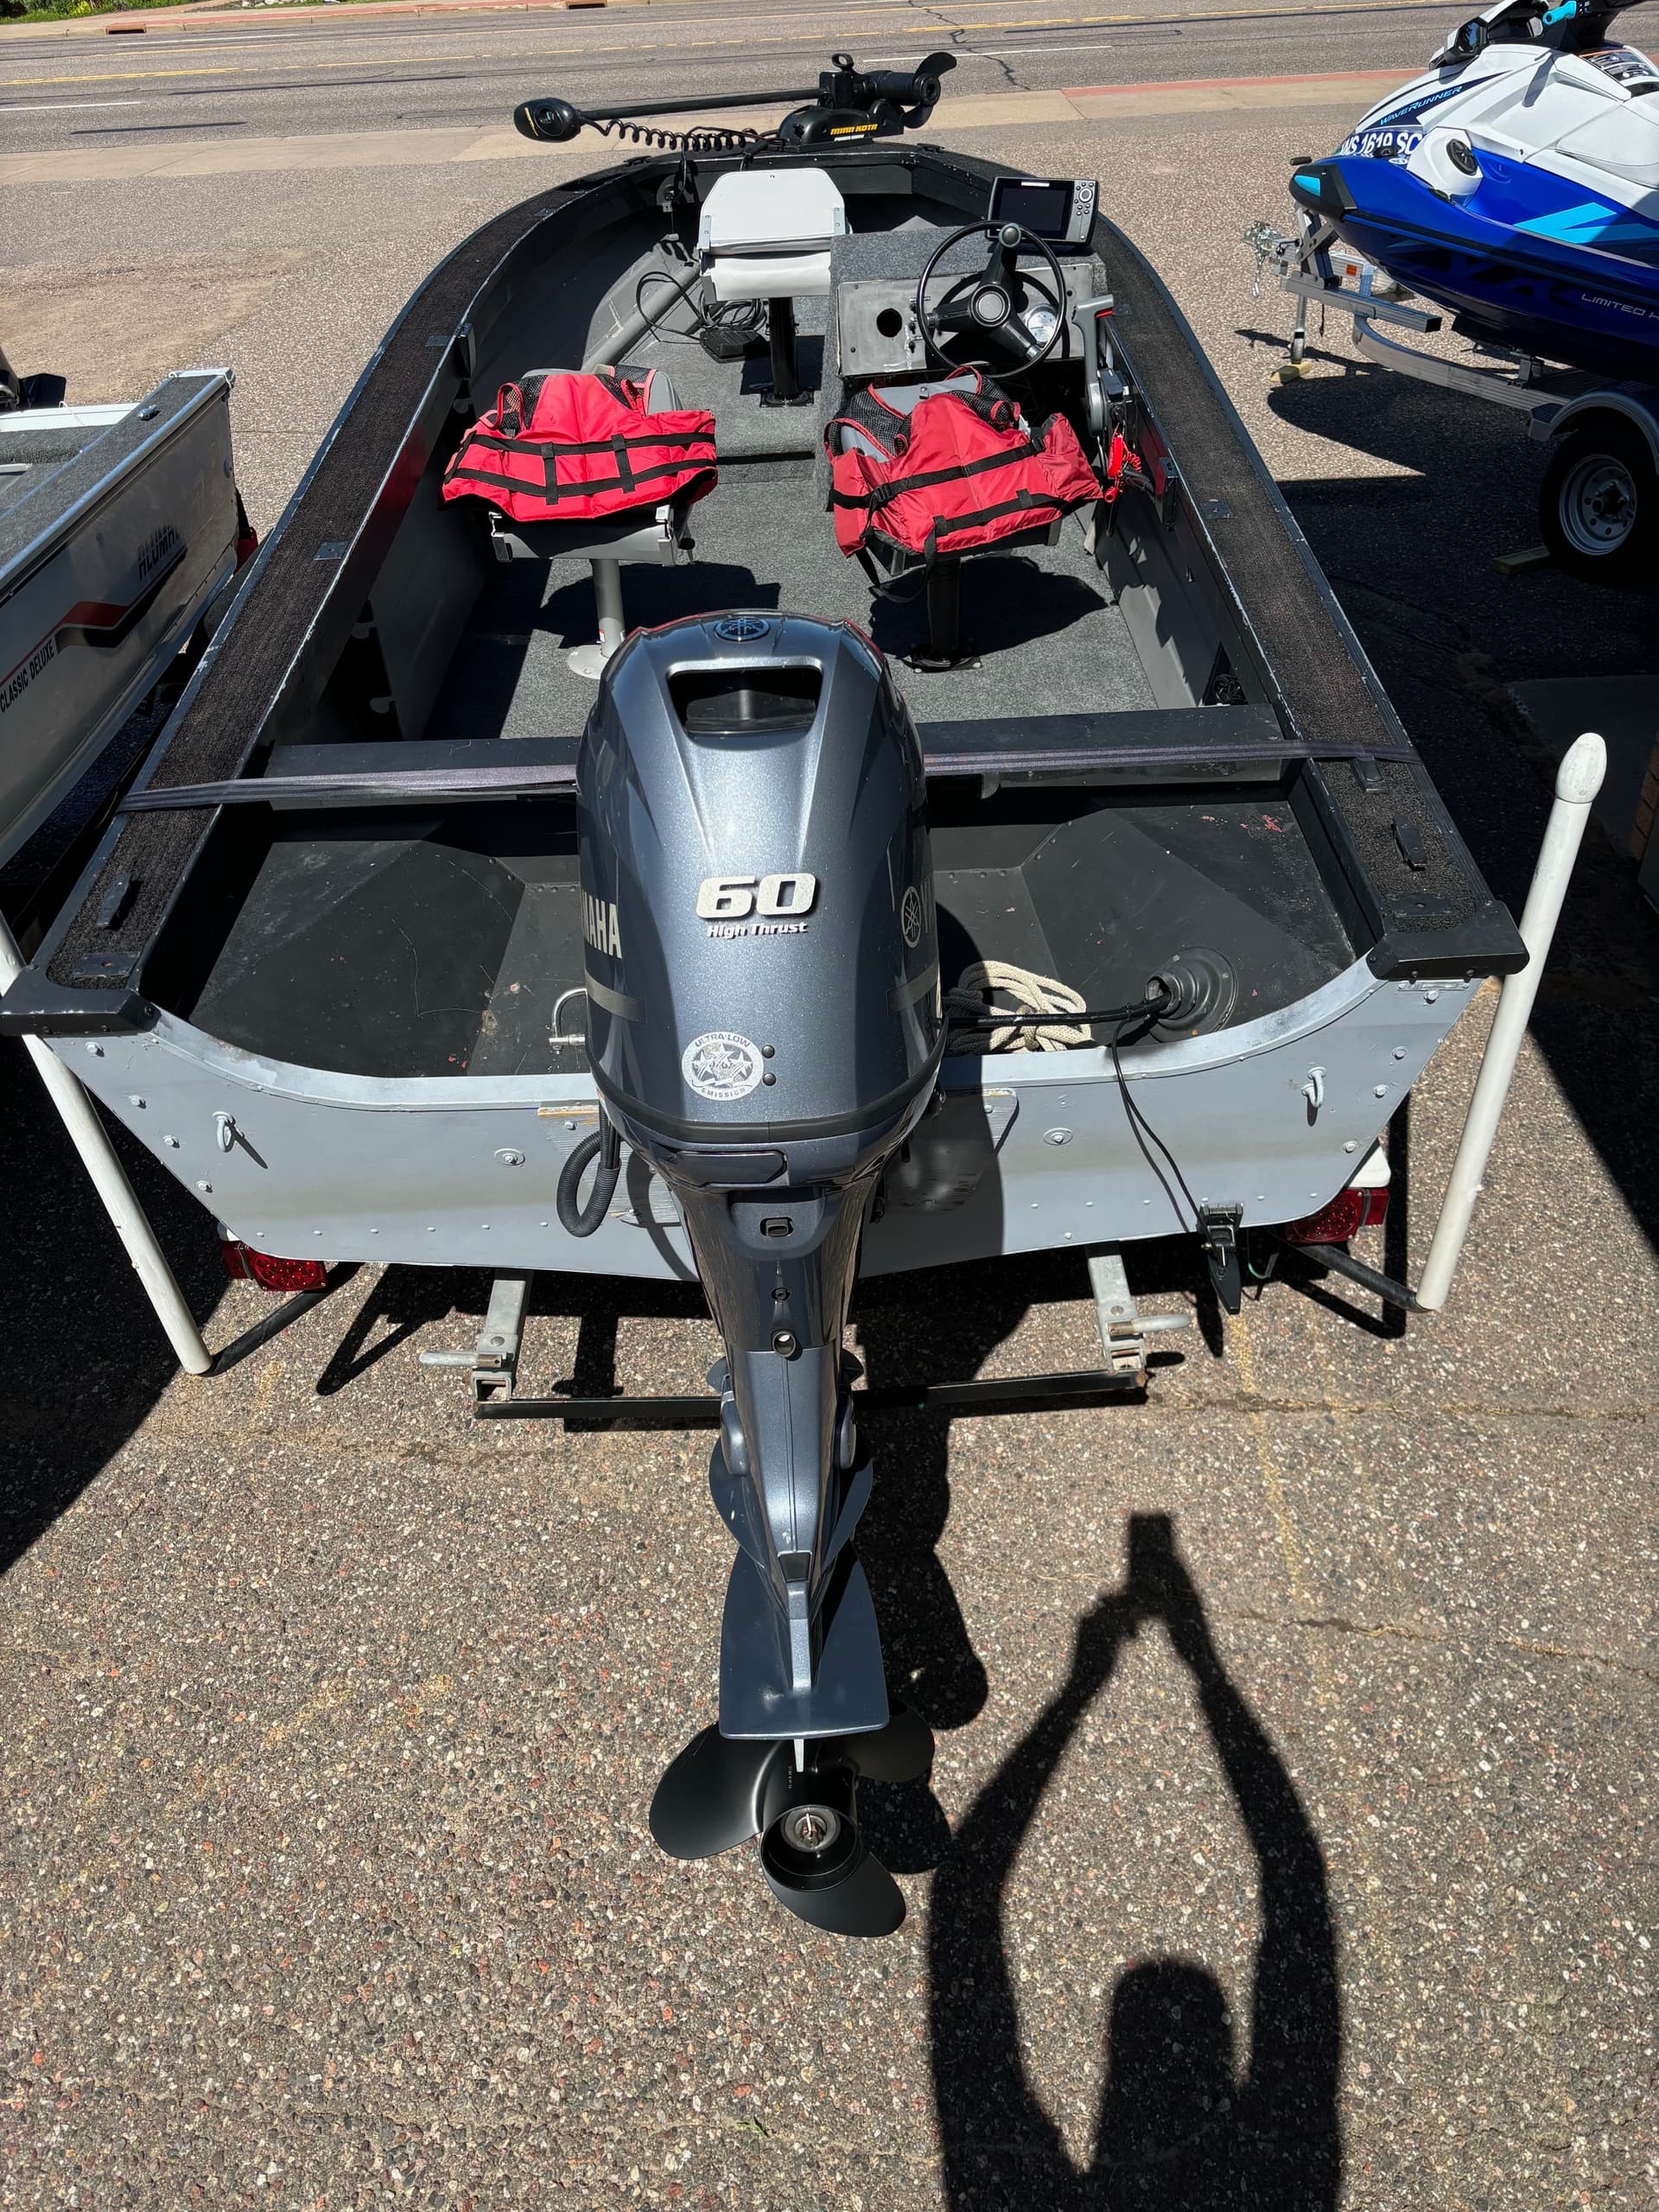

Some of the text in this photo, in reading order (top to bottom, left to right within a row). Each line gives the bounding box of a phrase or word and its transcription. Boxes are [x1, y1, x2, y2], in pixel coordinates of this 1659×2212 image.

[1581, 293, 1659, 321] LIMITED H
[0, 639, 55, 713] CLASSIC DELUXE
[696, 872, 817, 918] 60
[707, 922, 808, 939] High Thrust
[701, 1087, 747, 1098] EMISSION
